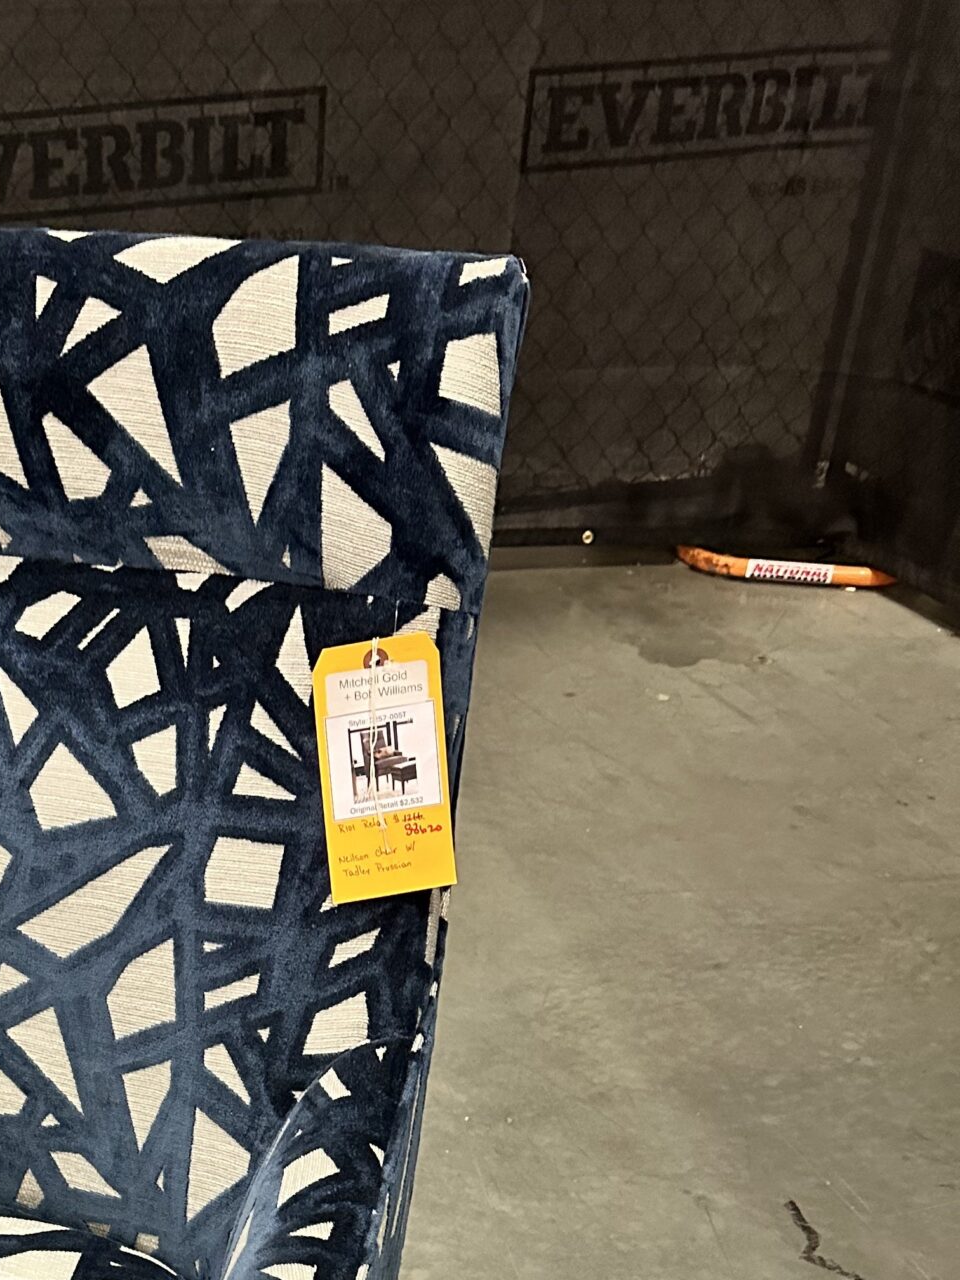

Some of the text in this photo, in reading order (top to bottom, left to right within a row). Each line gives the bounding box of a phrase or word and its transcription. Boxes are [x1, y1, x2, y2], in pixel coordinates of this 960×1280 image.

[339, 670, 408, 689] Mitchell Gold
[344, 693, 352, 702] +
[378, 683, 423, 697] Williams
